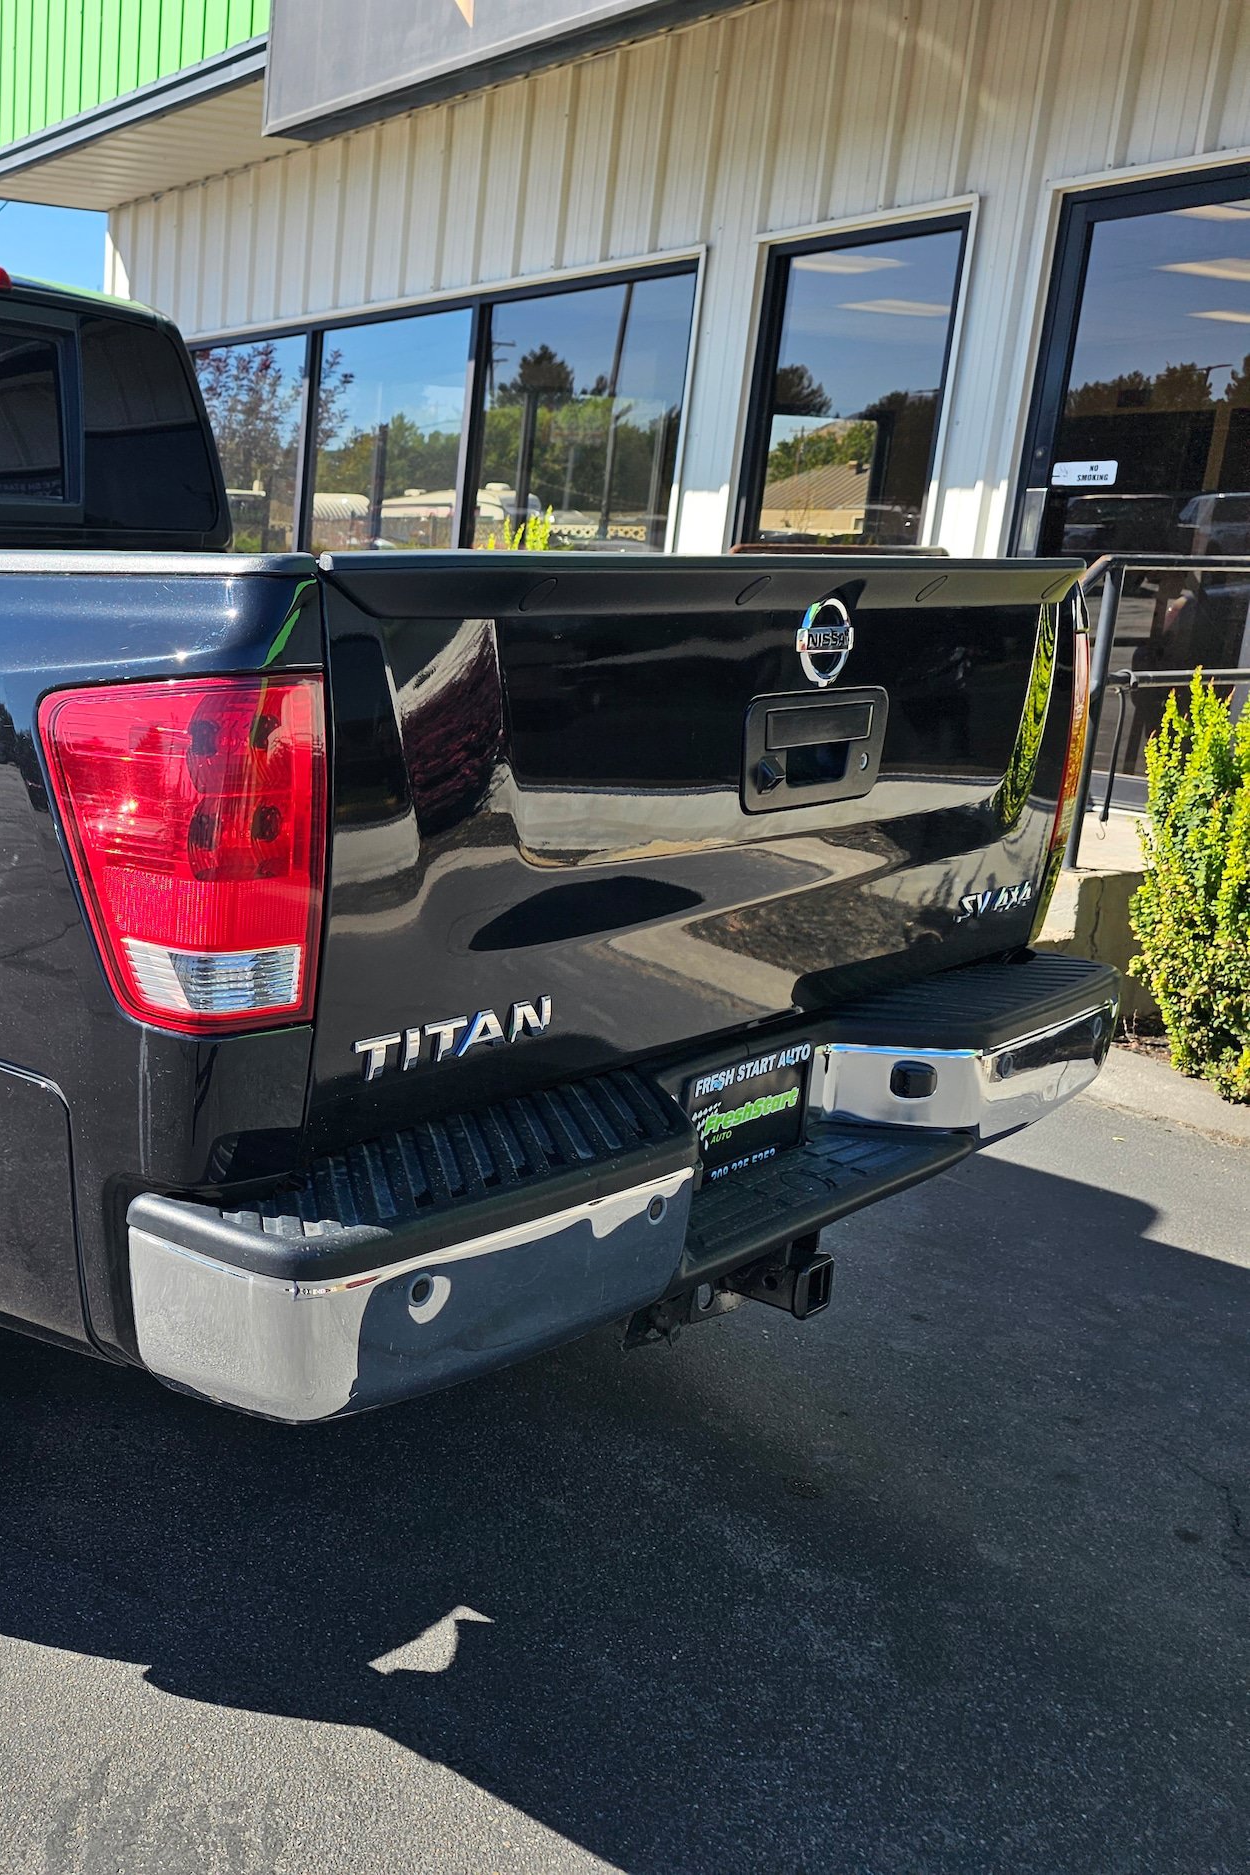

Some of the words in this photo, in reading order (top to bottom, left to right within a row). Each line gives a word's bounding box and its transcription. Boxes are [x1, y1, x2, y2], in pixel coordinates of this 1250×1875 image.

[1076, 474, 1109, 482] SMOKING
[1089, 464, 1099, 472] NO
[953, 891, 992, 923] SV
[354, 994, 552, 1082] TITAN
[694, 1067, 736, 1098] FRESH
[736, 1053, 778, 1083] START
[777, 1043, 811, 1069] AUTO
[710, 1129, 733, 1145] AUTO
